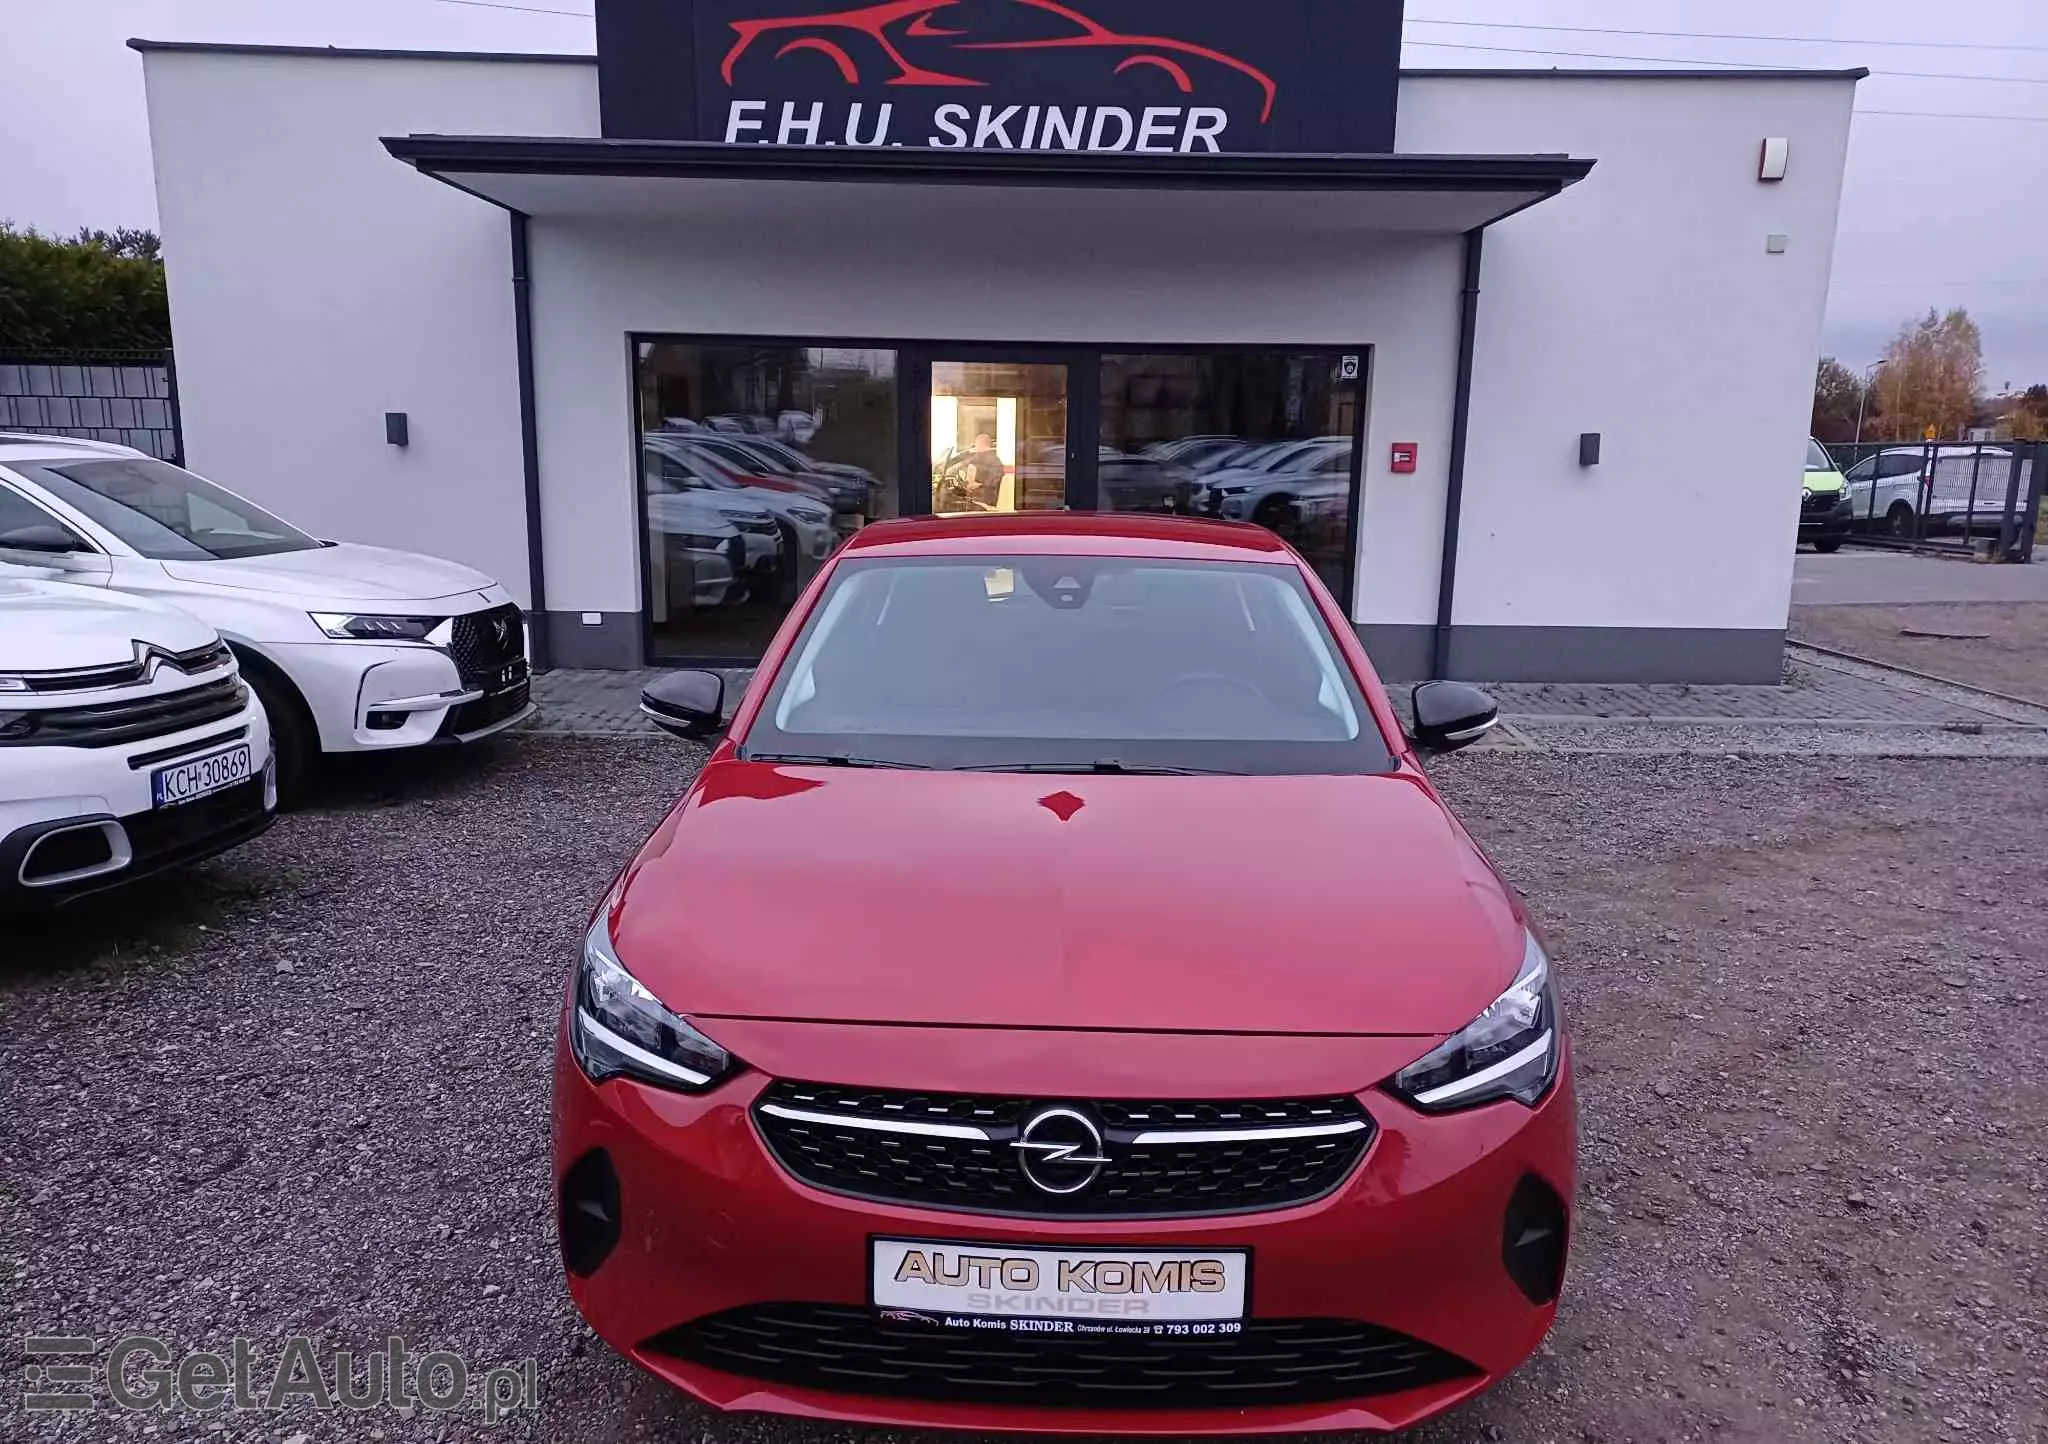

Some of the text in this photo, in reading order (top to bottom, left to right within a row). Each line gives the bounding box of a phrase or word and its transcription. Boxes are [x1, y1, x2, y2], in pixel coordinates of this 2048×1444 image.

[928, 103, 1228, 152] SKINDER
[165, 765, 199, 799] KCH
[202, 750, 247, 786] 30869
[895, 1250, 1226, 1294] AUTO KOMIS
[945, 1317, 970, 1328] Auto
[973, 1318, 1007, 1329] Komis
[1010, 1320, 1074, 1332] SKINDER
[1166, 1324, 1189, 1334] 793
[1193, 1324, 1215, 1334] 002
[1218, 1323, 1242, 1333] 309
[967, 1293, 1149, 1315] SKINDER
